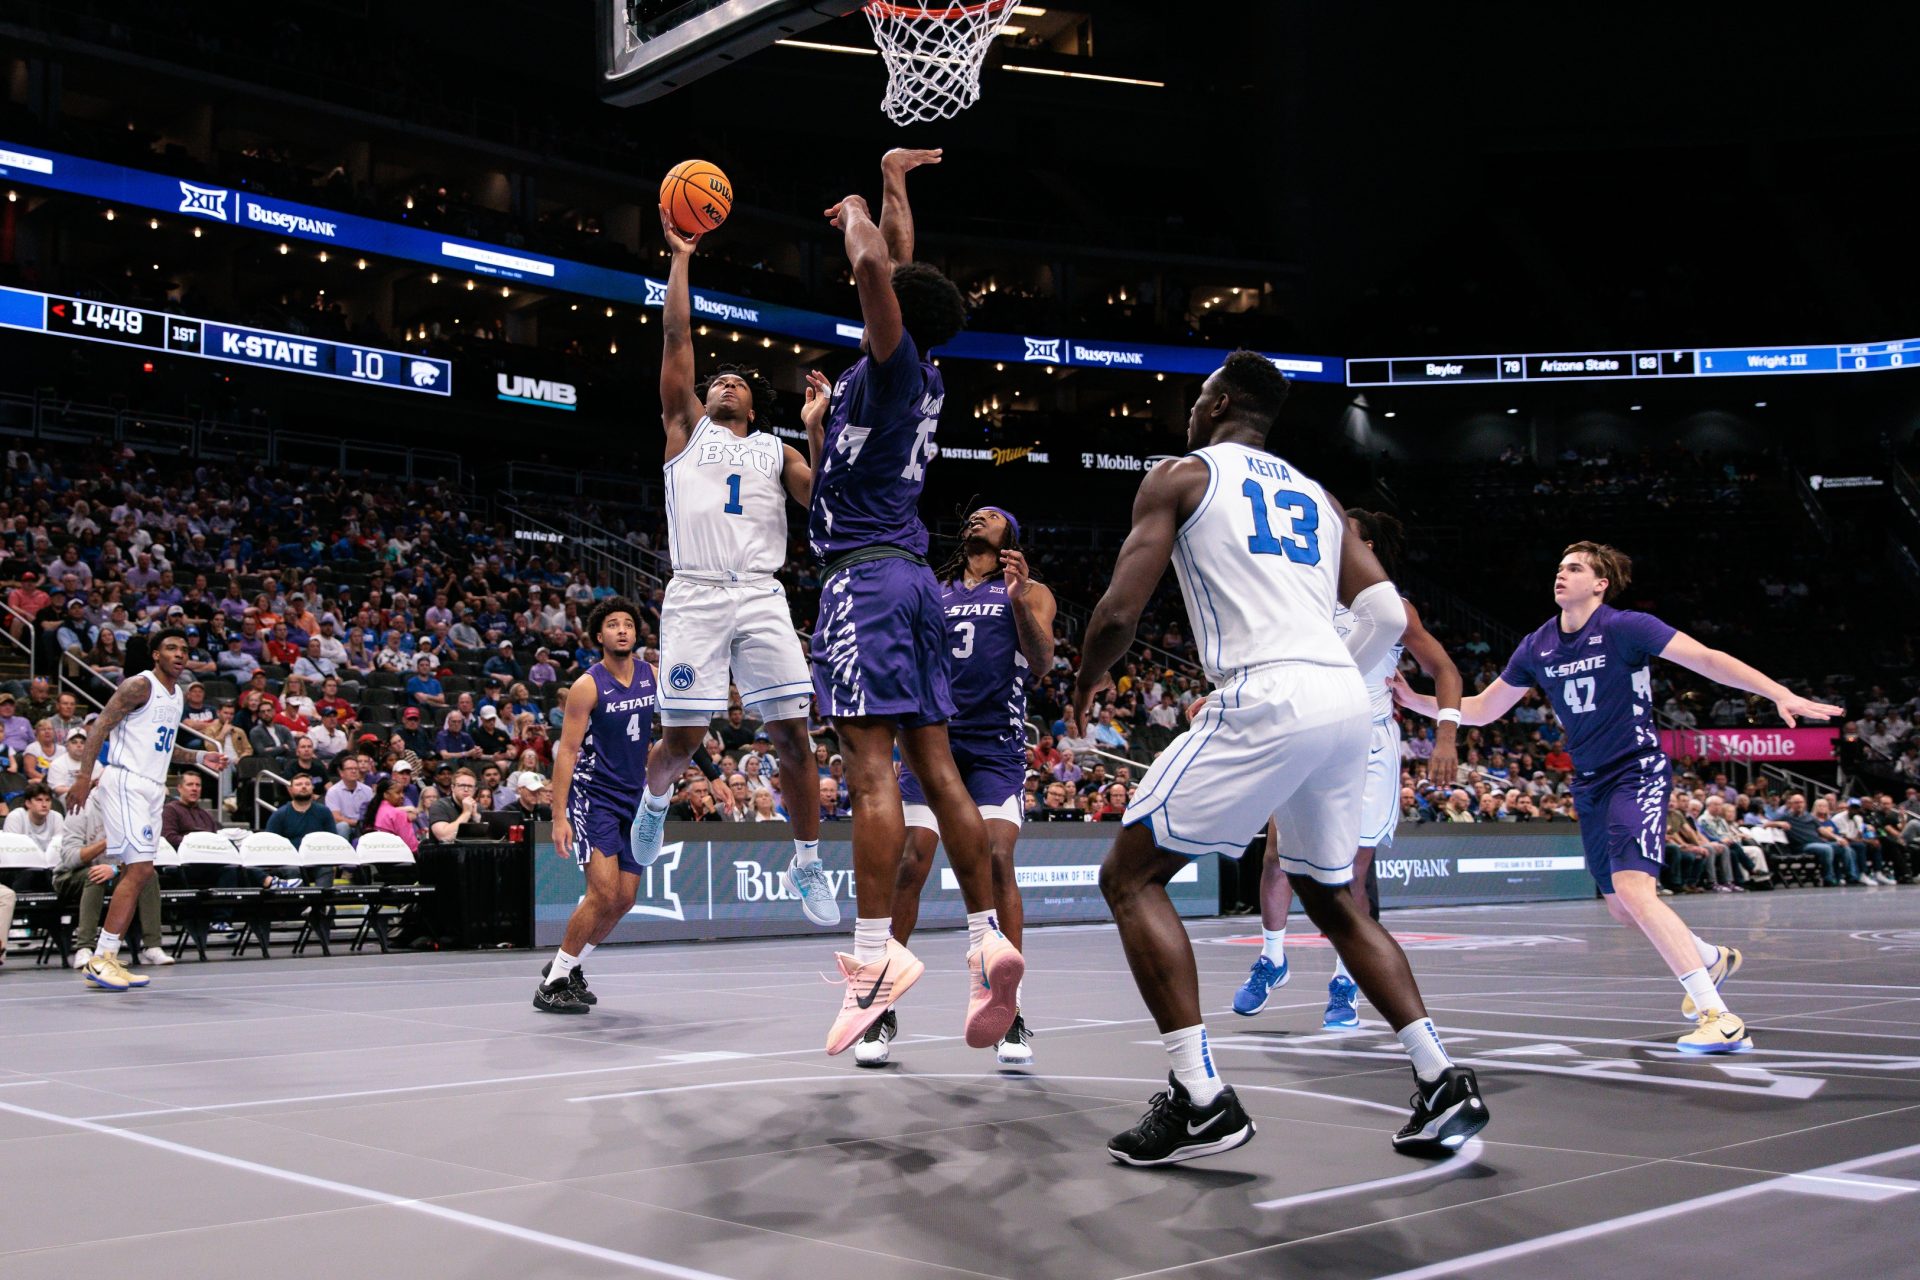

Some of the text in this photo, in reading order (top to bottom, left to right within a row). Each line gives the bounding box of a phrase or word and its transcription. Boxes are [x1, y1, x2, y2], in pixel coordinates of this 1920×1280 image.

[71, 301, 384, 381] 14:49 1ST K-STATE 10
[1425, 351, 1903, 377] Baylor 79 Arizona State 83 F 1 Wright III 0 0
[497, 373, 577, 405] UMB
[698, 442, 776, 479] BYU
[941, 447, 1050, 466] TASTES LIKE Miller TIME
[1096, 453, 1142, 471] Mobile
[1244, 455, 1293, 483] KEITA
[724, 473, 744, 515] 1
[1241, 477, 1322, 568] 13
[951, 621, 976, 659] 3
[1544, 654, 1607, 678] K-STATE
[605, 694, 655, 713] K-STATE
[1563, 676, 1597, 714] 47
[154, 725, 176, 753] 30
[626, 713, 641, 742] 4
[1718, 734, 1795, 756] Mobile
[1017, 871, 1095, 883] OFFICIAL BANK OF THE
[1375, 859, 1450, 886] useyBANK
